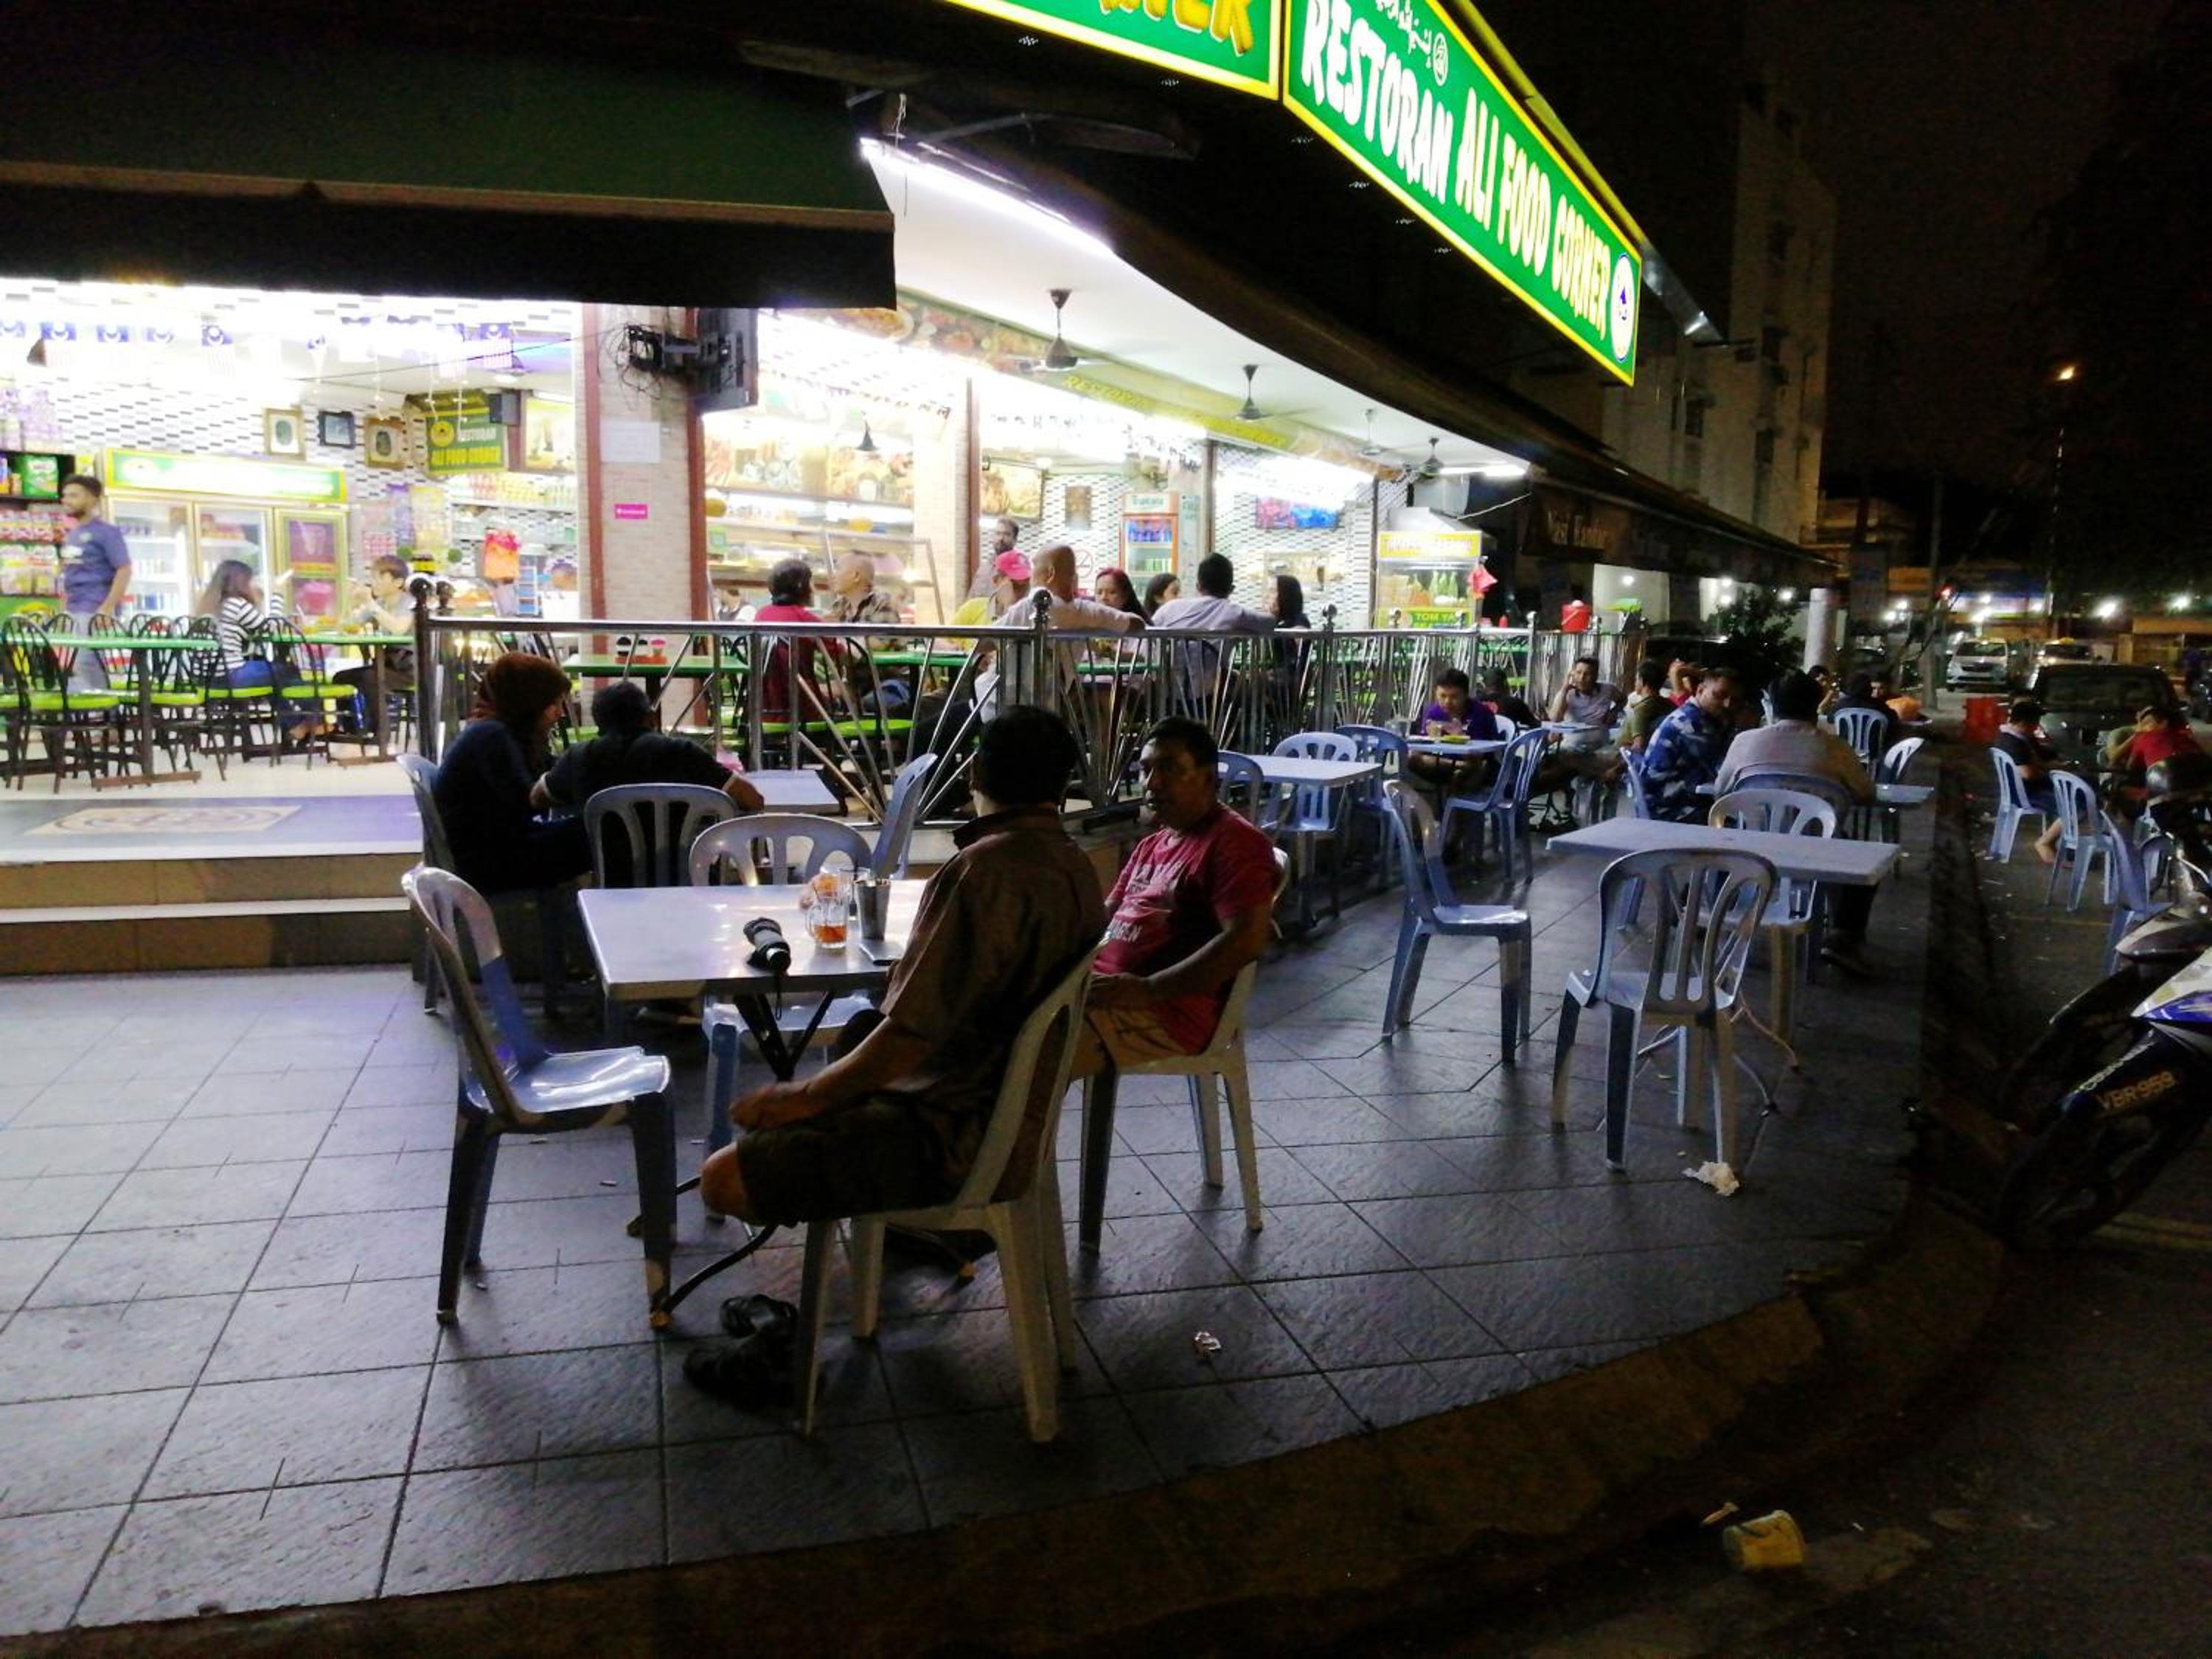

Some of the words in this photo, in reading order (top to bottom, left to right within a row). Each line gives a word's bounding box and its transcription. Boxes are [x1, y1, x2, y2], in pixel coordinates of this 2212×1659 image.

[1301, 0, 1453, 204] RESTORAN
[1455, 87, 1499, 232] ALI
[1497, 133, 1551, 276] FOOD
[1551, 194, 1611, 341] CORNER
